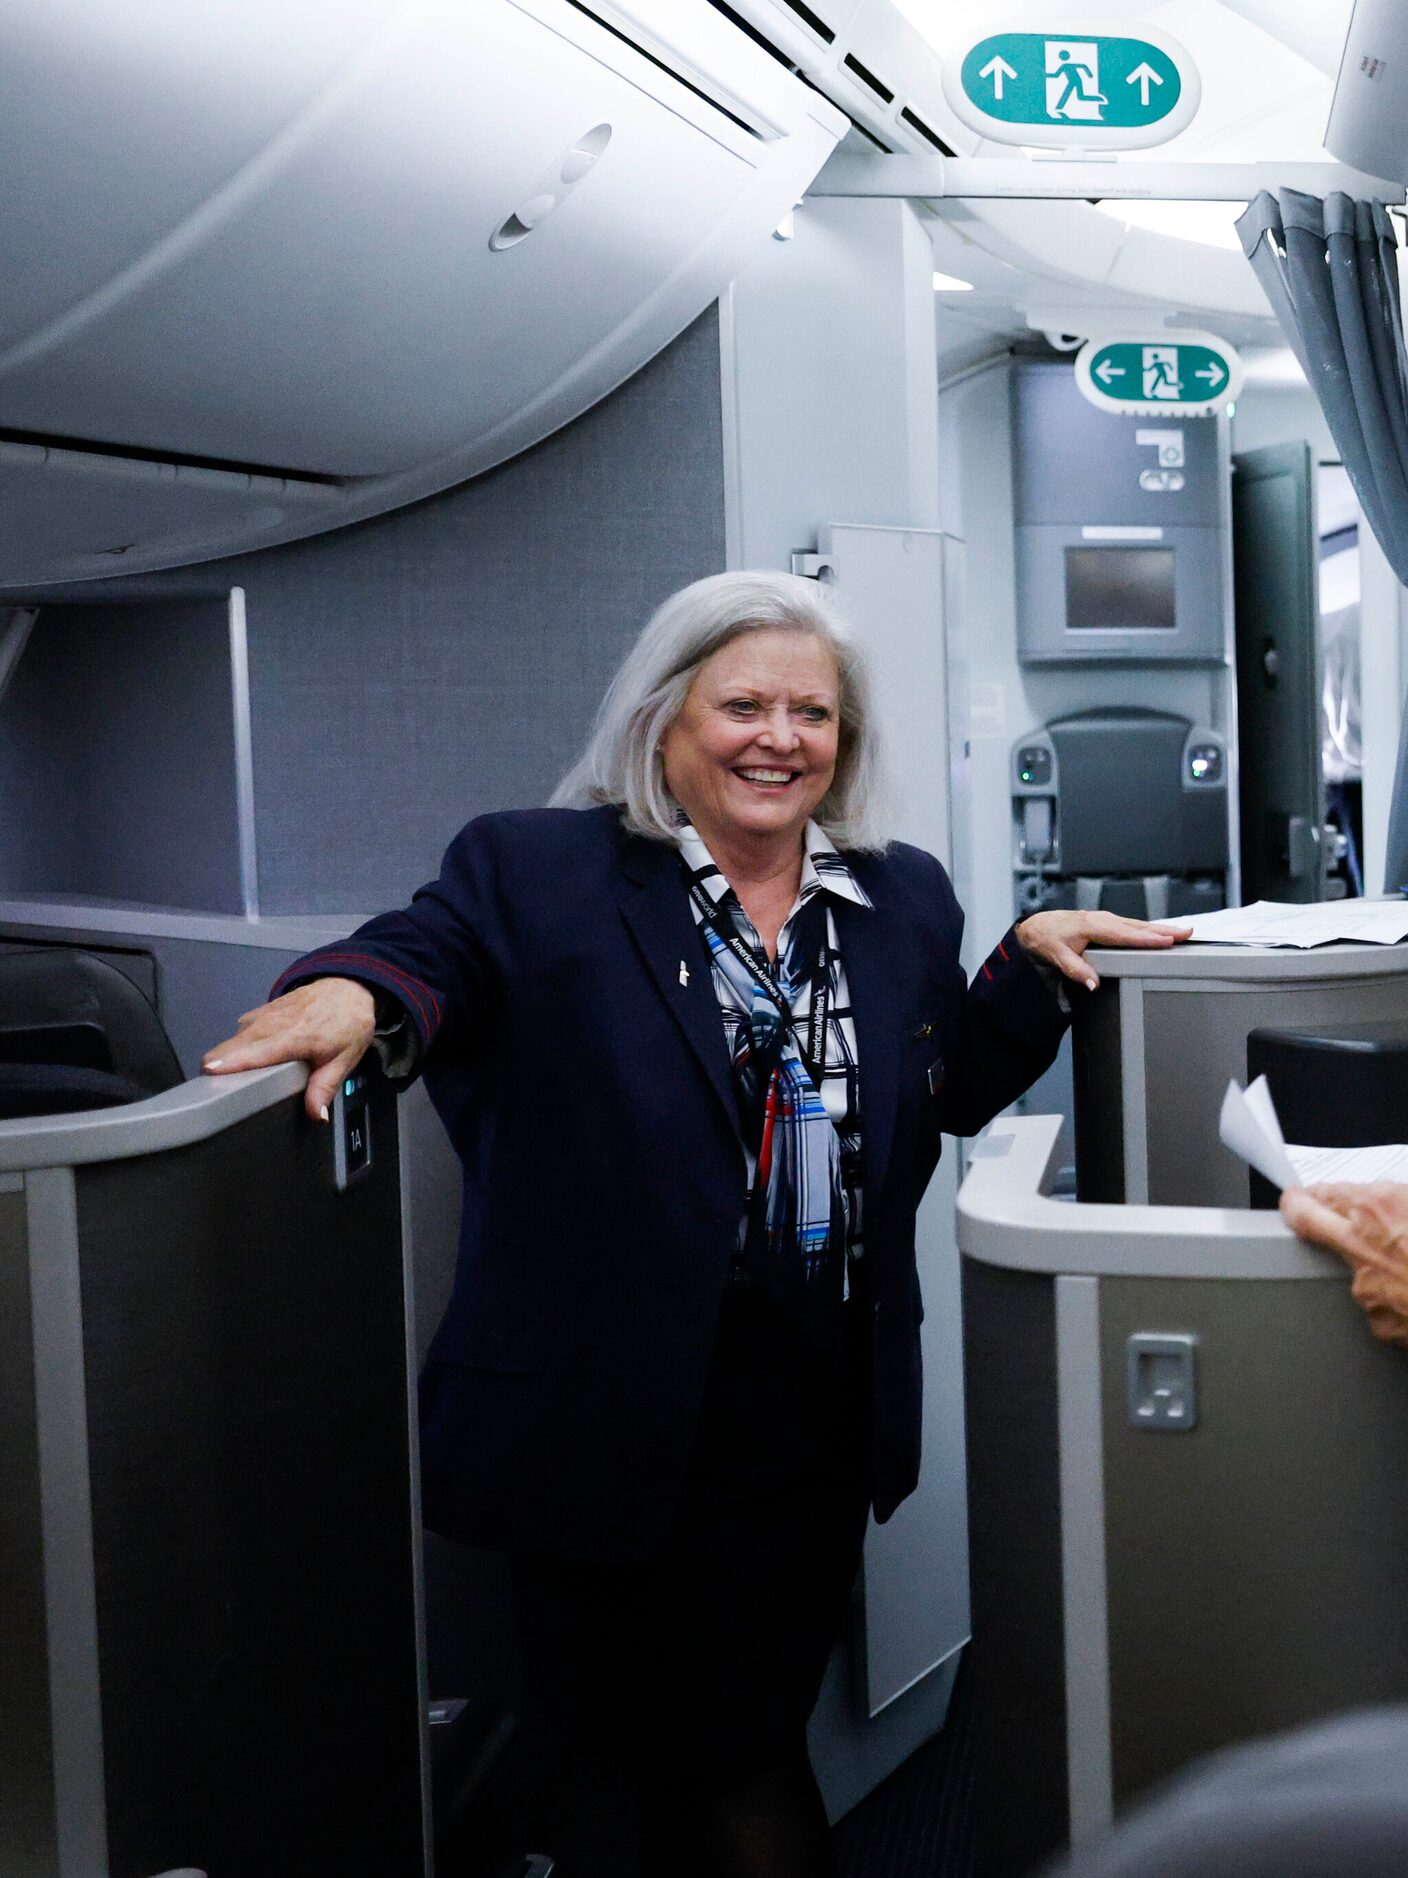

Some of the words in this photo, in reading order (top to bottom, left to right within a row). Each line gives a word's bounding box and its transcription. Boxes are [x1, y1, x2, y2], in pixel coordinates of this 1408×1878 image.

[691, 885, 718, 919] oneworld
[729, 937, 759, 972] American
[755, 969, 779, 997] Airlines
[814, 996, 825, 1023] Airlines
[812, 1022, 824, 1065] American
[350, 1128, 362, 1151] 1A
